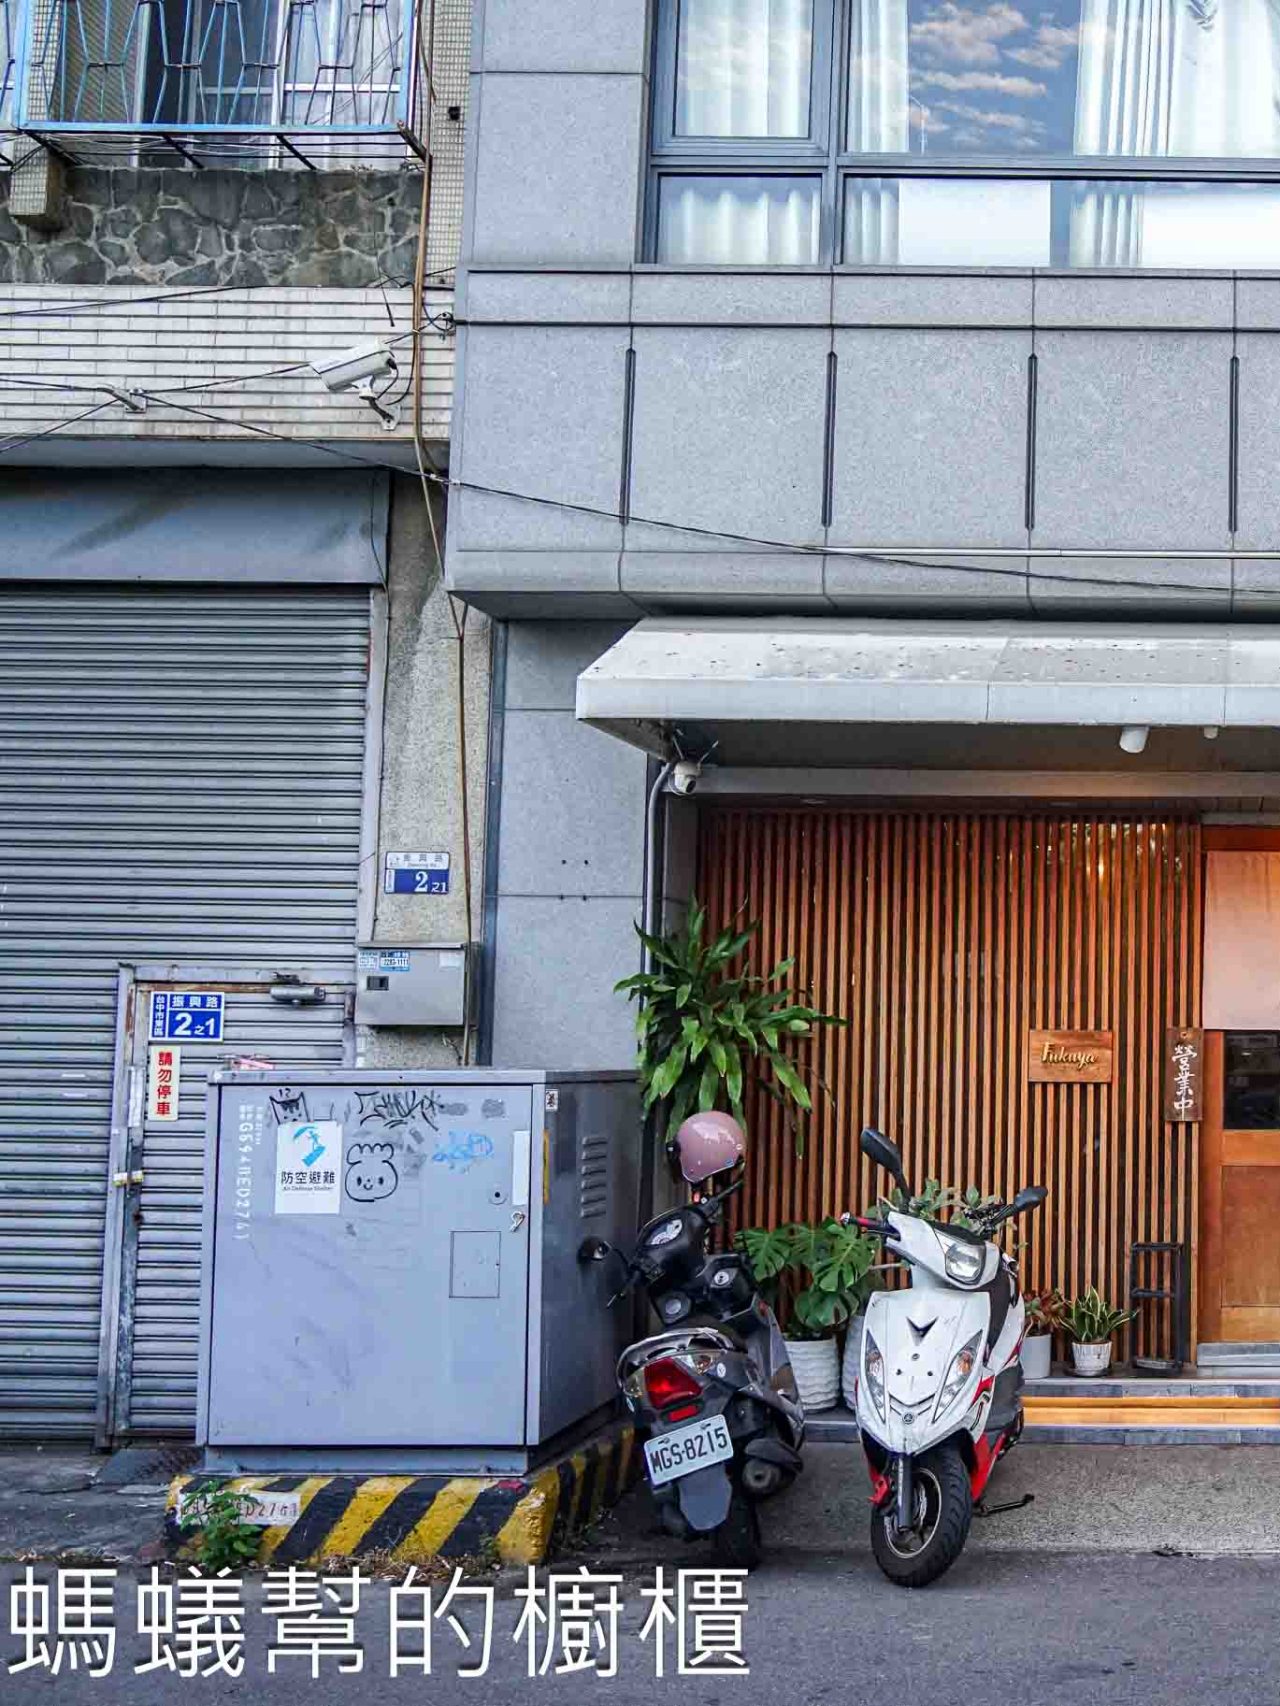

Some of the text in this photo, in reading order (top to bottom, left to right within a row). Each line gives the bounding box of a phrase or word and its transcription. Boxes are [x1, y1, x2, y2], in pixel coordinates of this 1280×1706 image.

[171, 996, 218, 1008] 振興路
[173, 1012, 215, 1036] 2之1
[157, 1051, 173, 1116] 請勿停車
[1172, 1044, 1198, 1121] 營業中
[281, 1171, 335, 1184] 防空避難
[650, 1427, 727, 1473] MGS-8215
